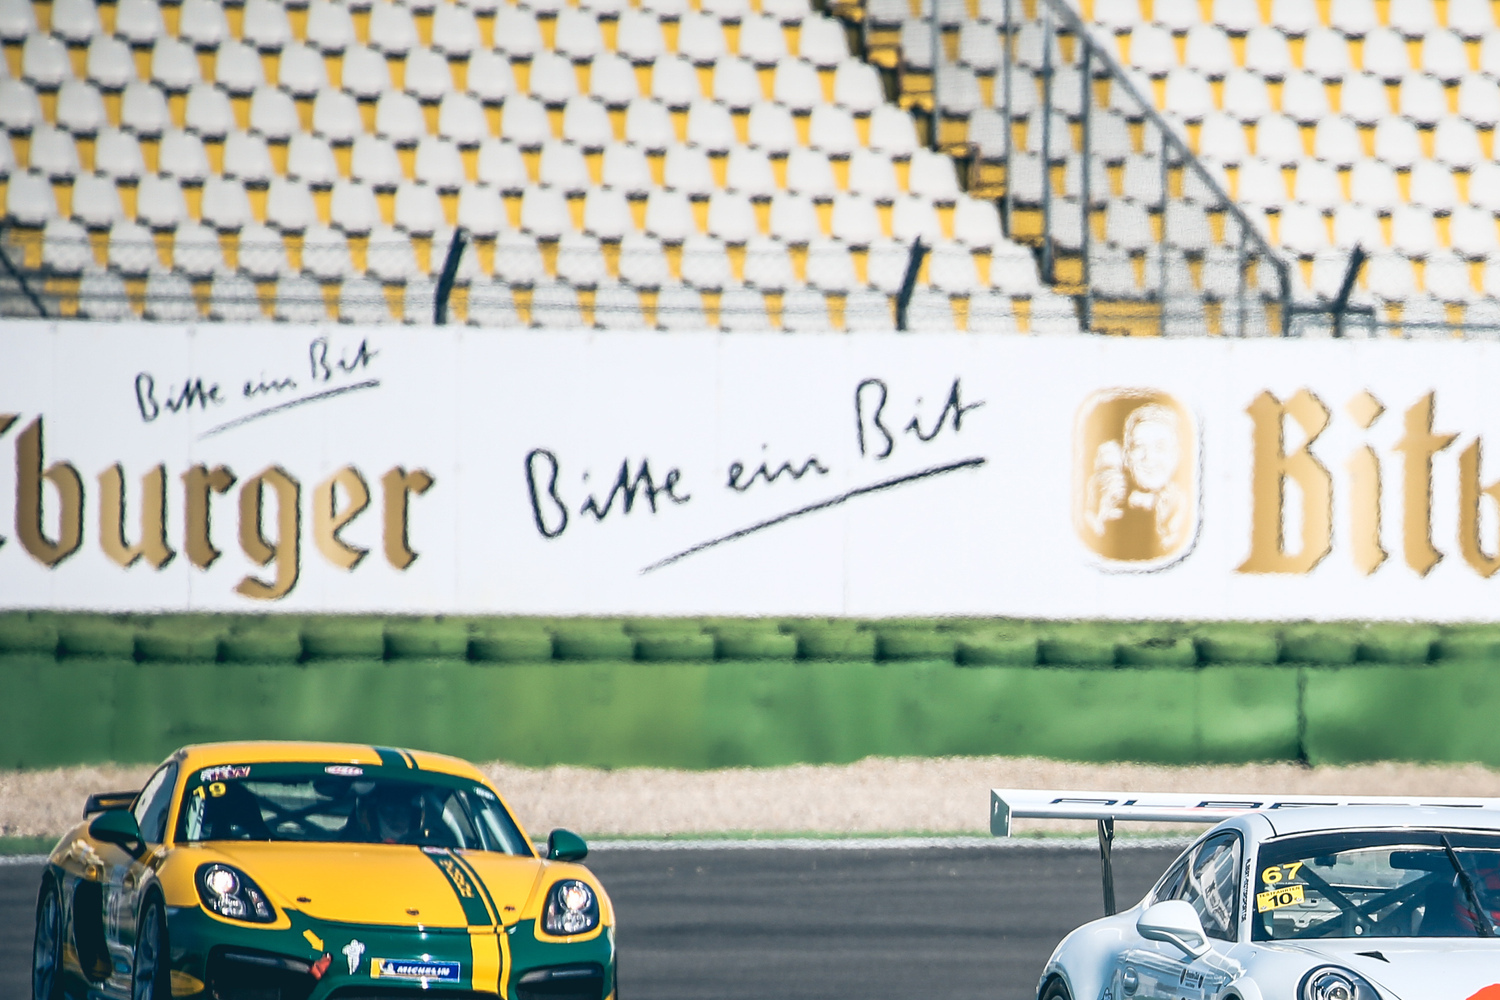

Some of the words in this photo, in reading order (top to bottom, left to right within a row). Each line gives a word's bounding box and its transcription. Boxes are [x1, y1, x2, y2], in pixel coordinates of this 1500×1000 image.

[134, 371, 224, 422] Bitte
[243, 371, 298, 399] ein
[309, 336, 380, 381] Bit
[525, 447, 691, 539] Bitte
[726, 443, 829, 493] ein
[854, 376, 987, 460] Bit
[0, 413, 436, 601] burger
[1262, 861, 1303, 885] 67
[1268, 892, 1293, 907] 10
[396, 965, 451, 977] MICHELIN
